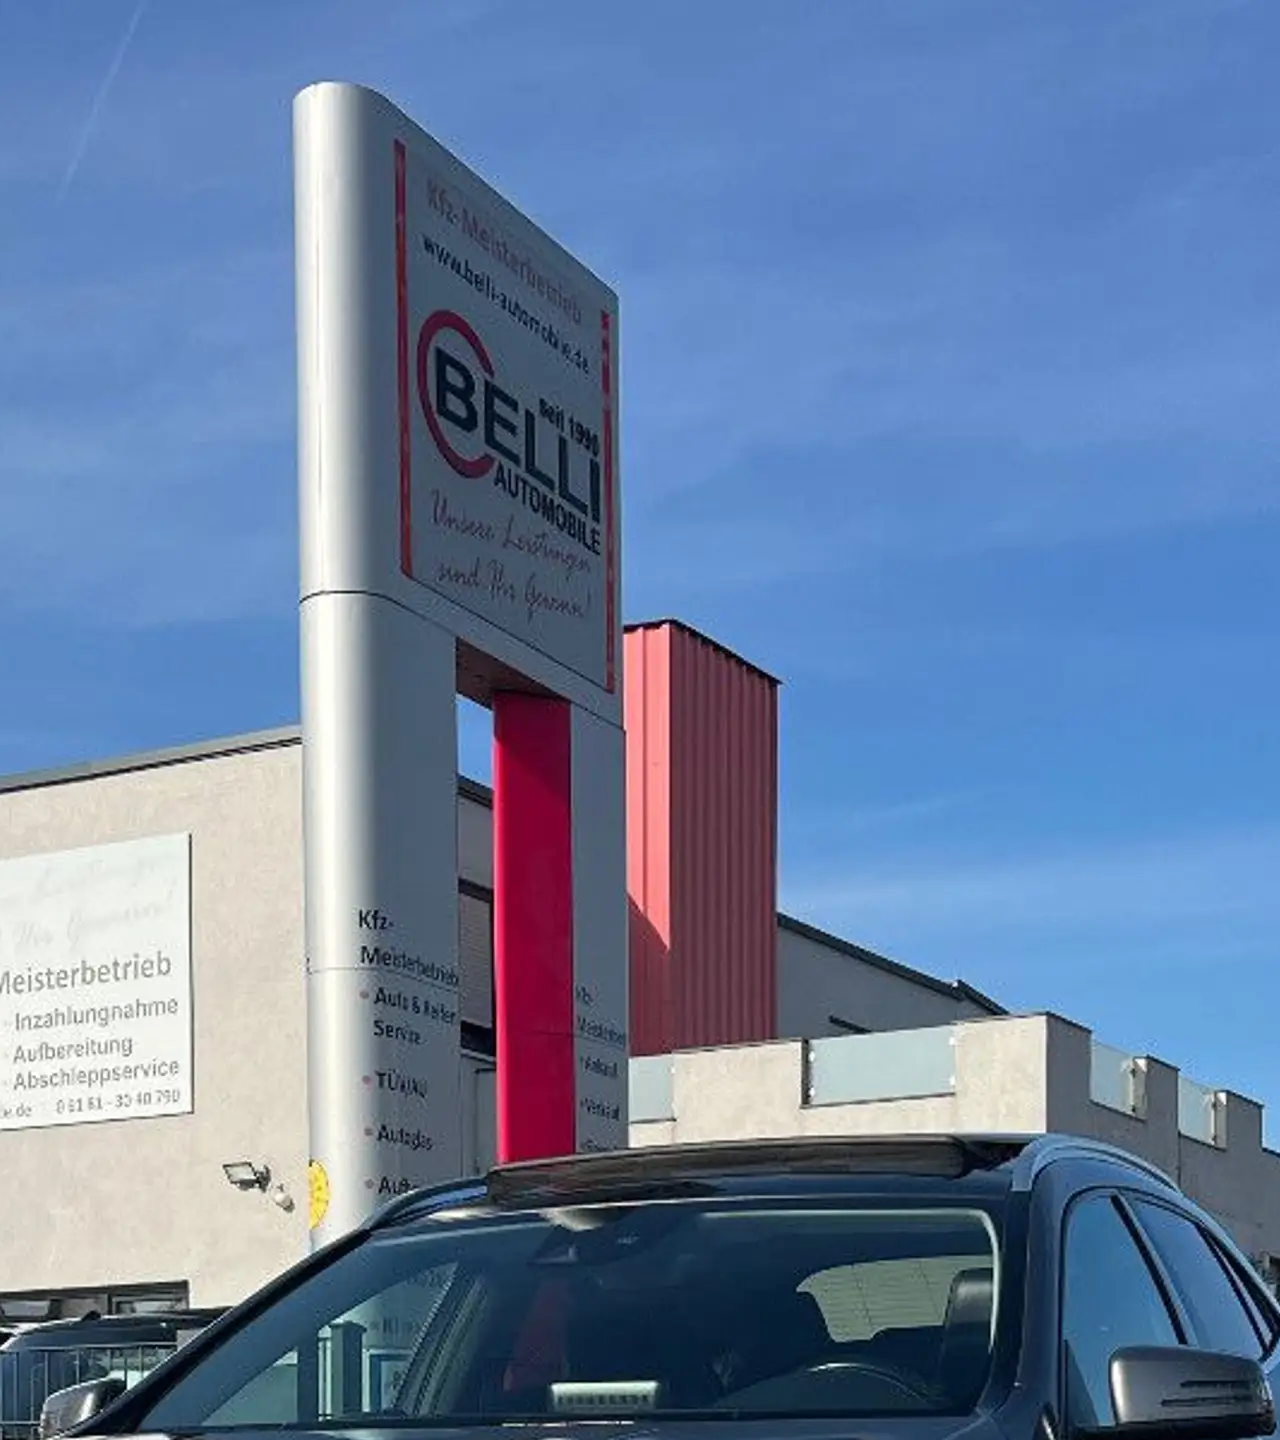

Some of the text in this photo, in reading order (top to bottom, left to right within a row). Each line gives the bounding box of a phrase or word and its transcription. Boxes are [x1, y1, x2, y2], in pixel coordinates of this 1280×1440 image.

[538, 397, 564, 426] seit
[434, 345, 601, 524] BELLI
[493, 462, 602, 556] AUTOMOBILE
[358, 908, 394, 931] Kfz-
[14, 997, 179, 1033] Inzahlungnahme
[13, 1036, 134, 1066] Aufbereitung
[13, 1058, 180, 1092] Abschleppservice
